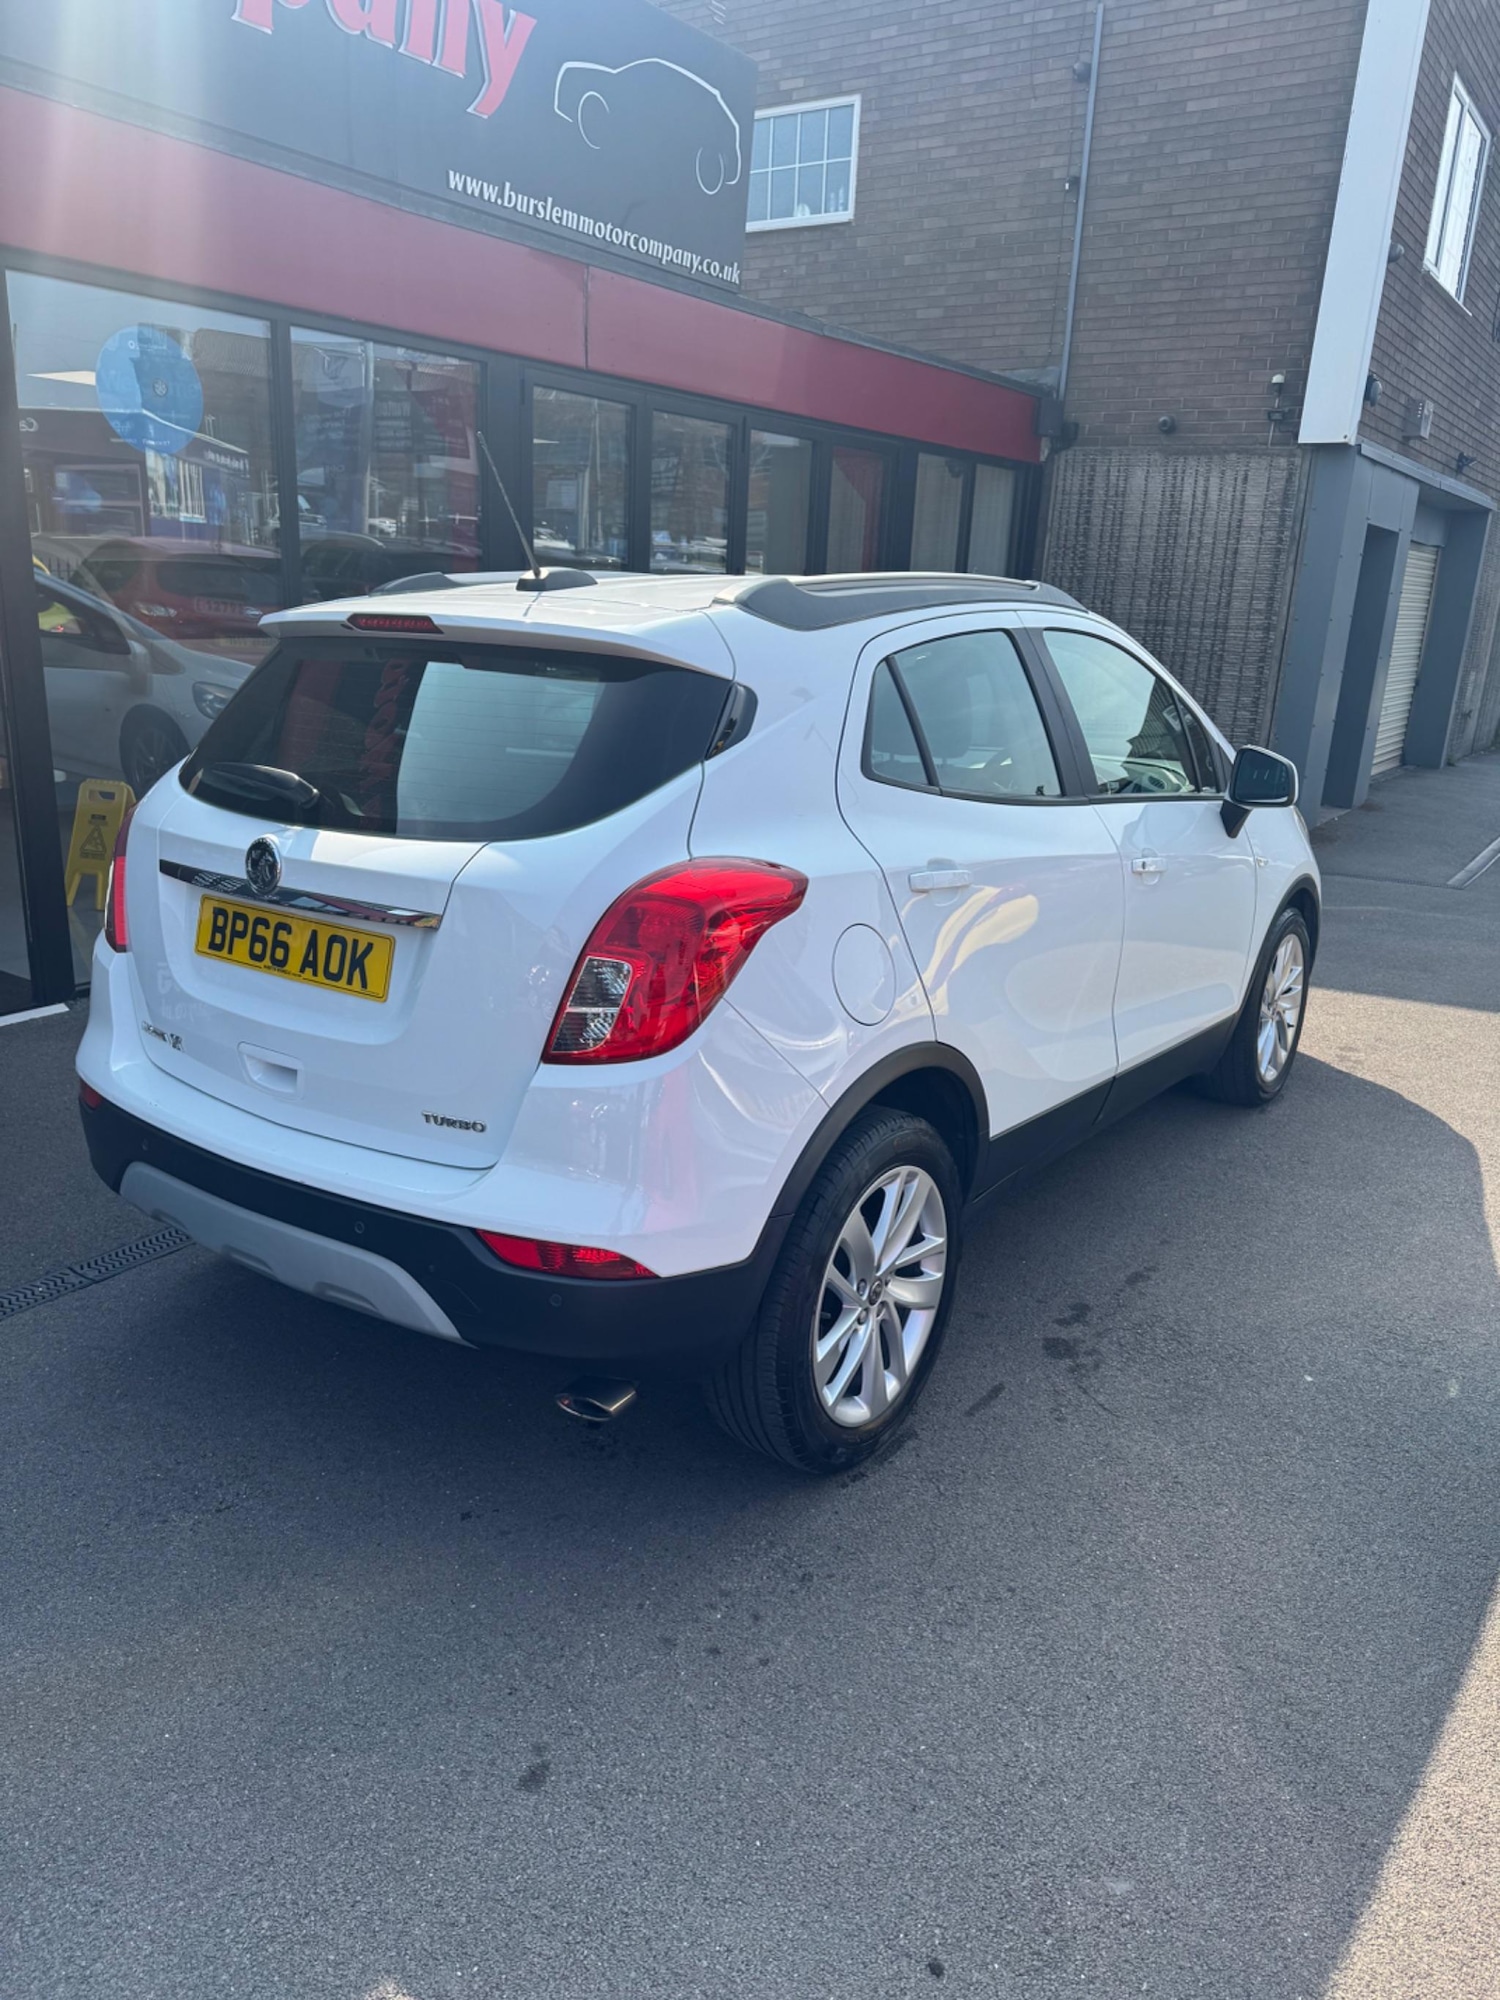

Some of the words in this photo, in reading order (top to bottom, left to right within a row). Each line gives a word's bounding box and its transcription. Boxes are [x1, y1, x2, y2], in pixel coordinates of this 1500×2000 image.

[447, 169, 740, 285] www.burslemmotorcompany.co.uk
[208, 906, 292, 968] BP66
[299, 929, 374, 990] AOK
[422, 1110, 487, 1133] TURBO
